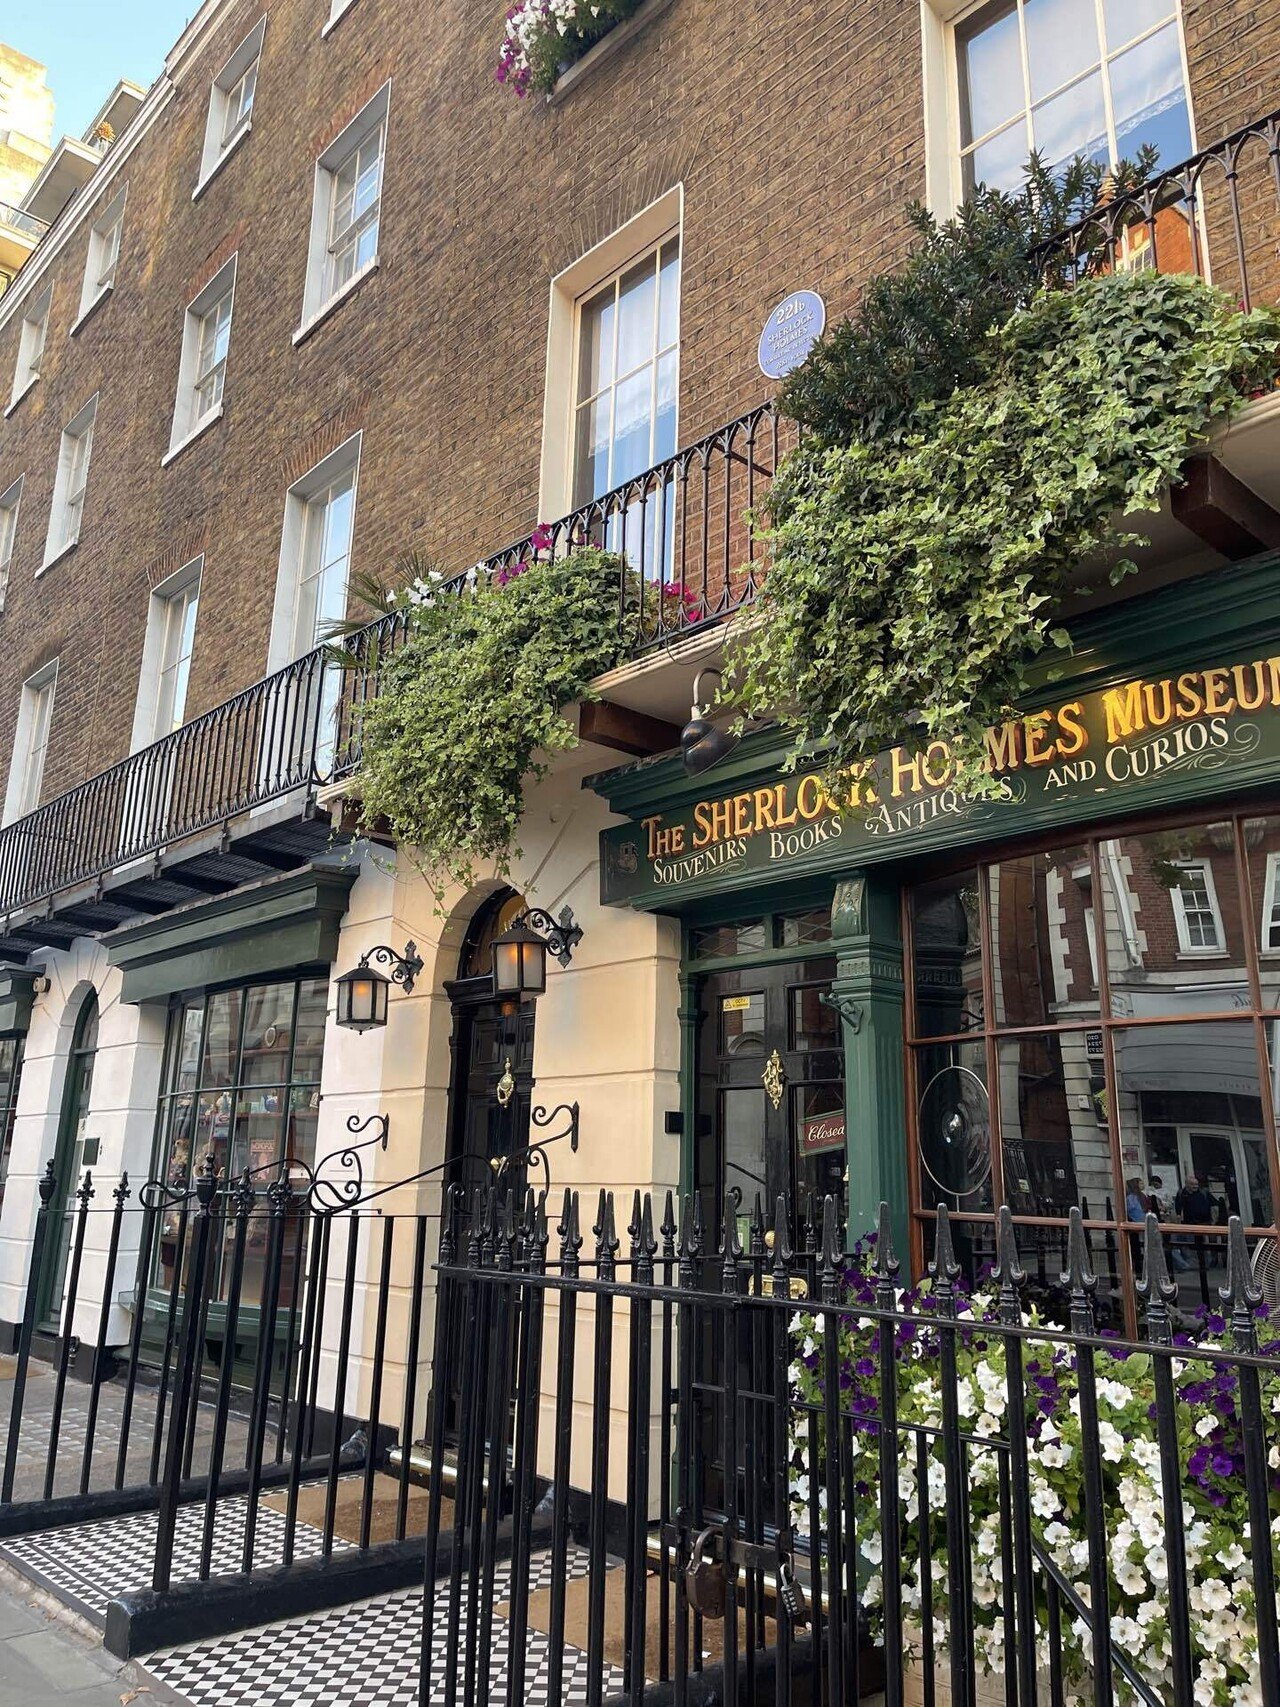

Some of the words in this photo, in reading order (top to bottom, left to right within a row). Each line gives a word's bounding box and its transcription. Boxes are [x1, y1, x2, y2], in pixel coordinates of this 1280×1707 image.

[777, 299, 805, 325] 221b
[768, 311, 814, 342] SHERLOCK
[774, 328, 808, 351] HOLMES
[653, 837, 748, 884] SOUVENIRS
[769, 815, 843, 860] BOOKS
[1043, 760, 1097, 791] AND
[1105, 717, 1230, 782] CURIOS
[808, 1124, 845, 1142] Closed
